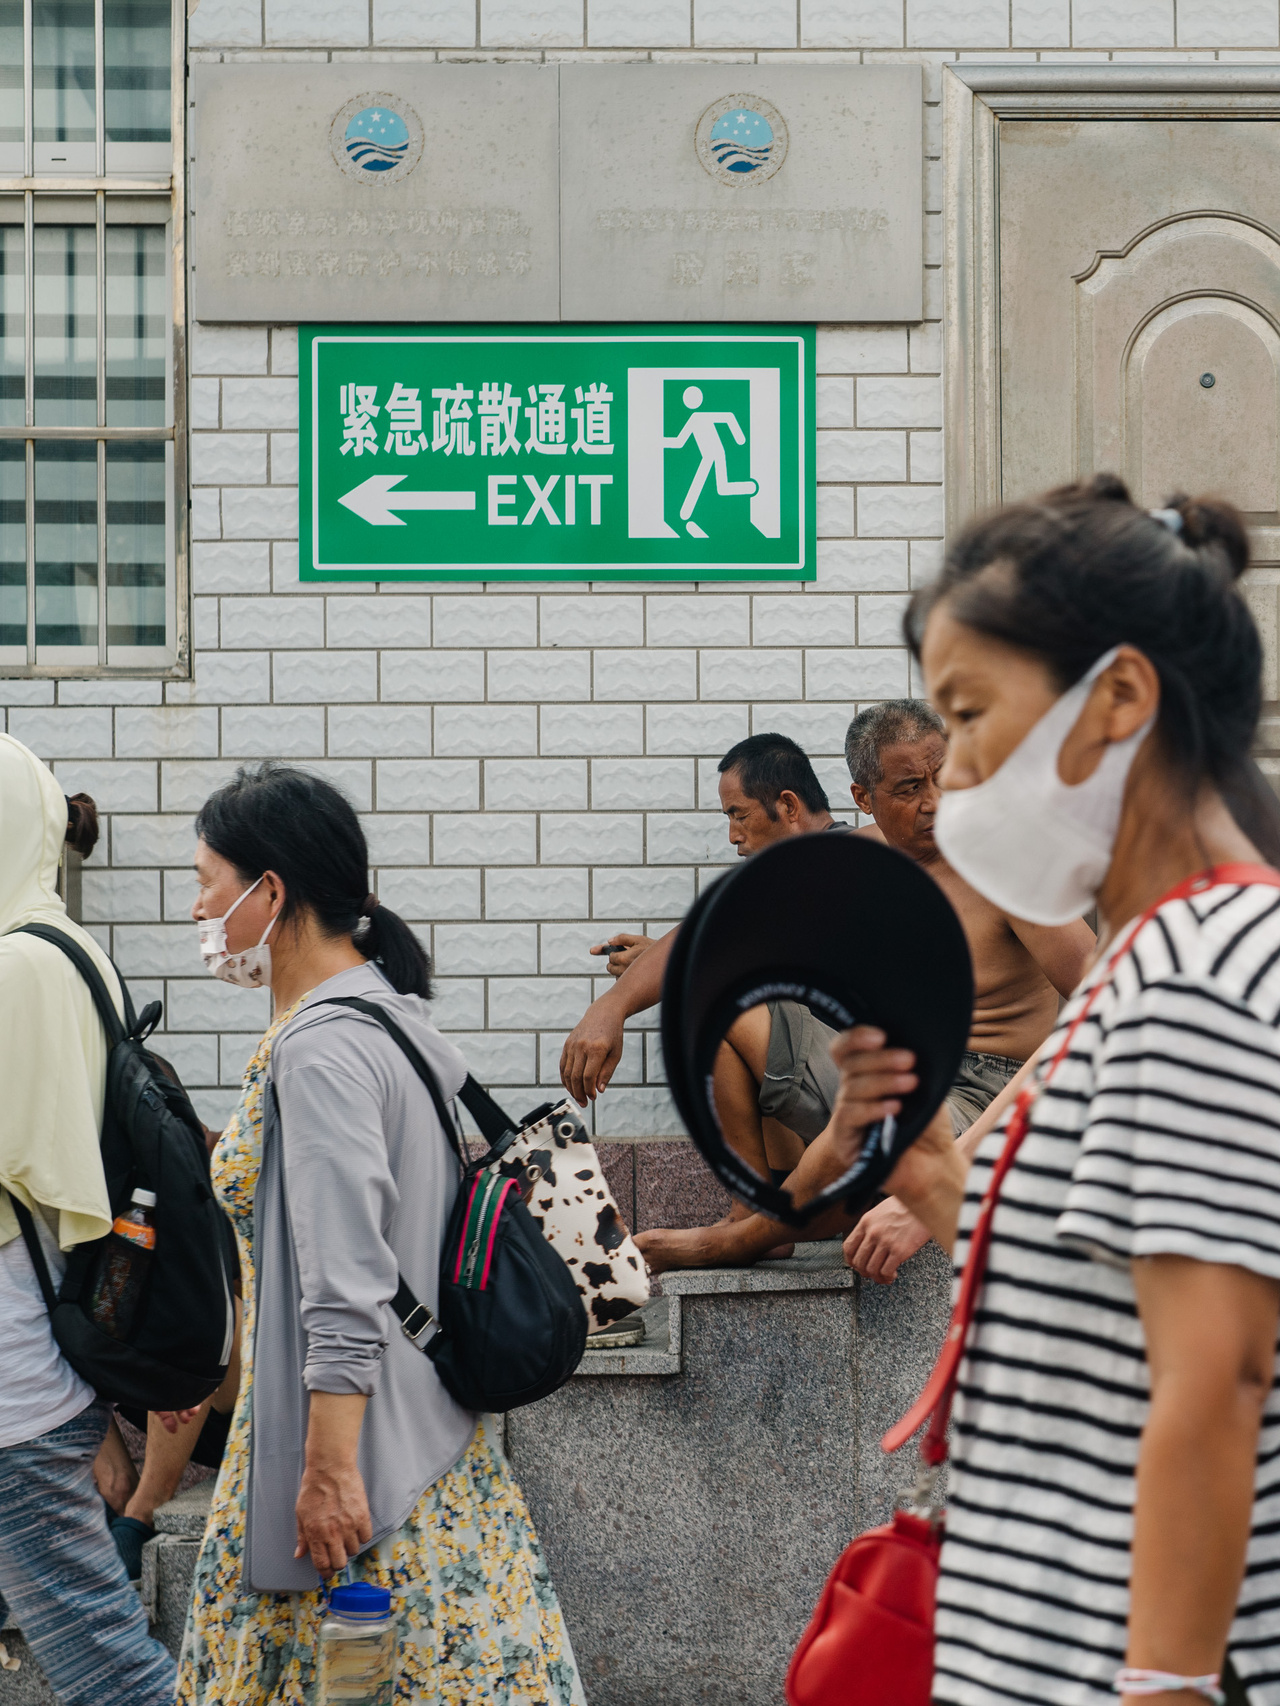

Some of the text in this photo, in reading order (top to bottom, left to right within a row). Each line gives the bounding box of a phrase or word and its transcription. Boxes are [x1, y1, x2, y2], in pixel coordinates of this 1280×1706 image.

[339, 381, 615, 457] 紧急疏散通道
[487, 474, 614, 526] EXIT
